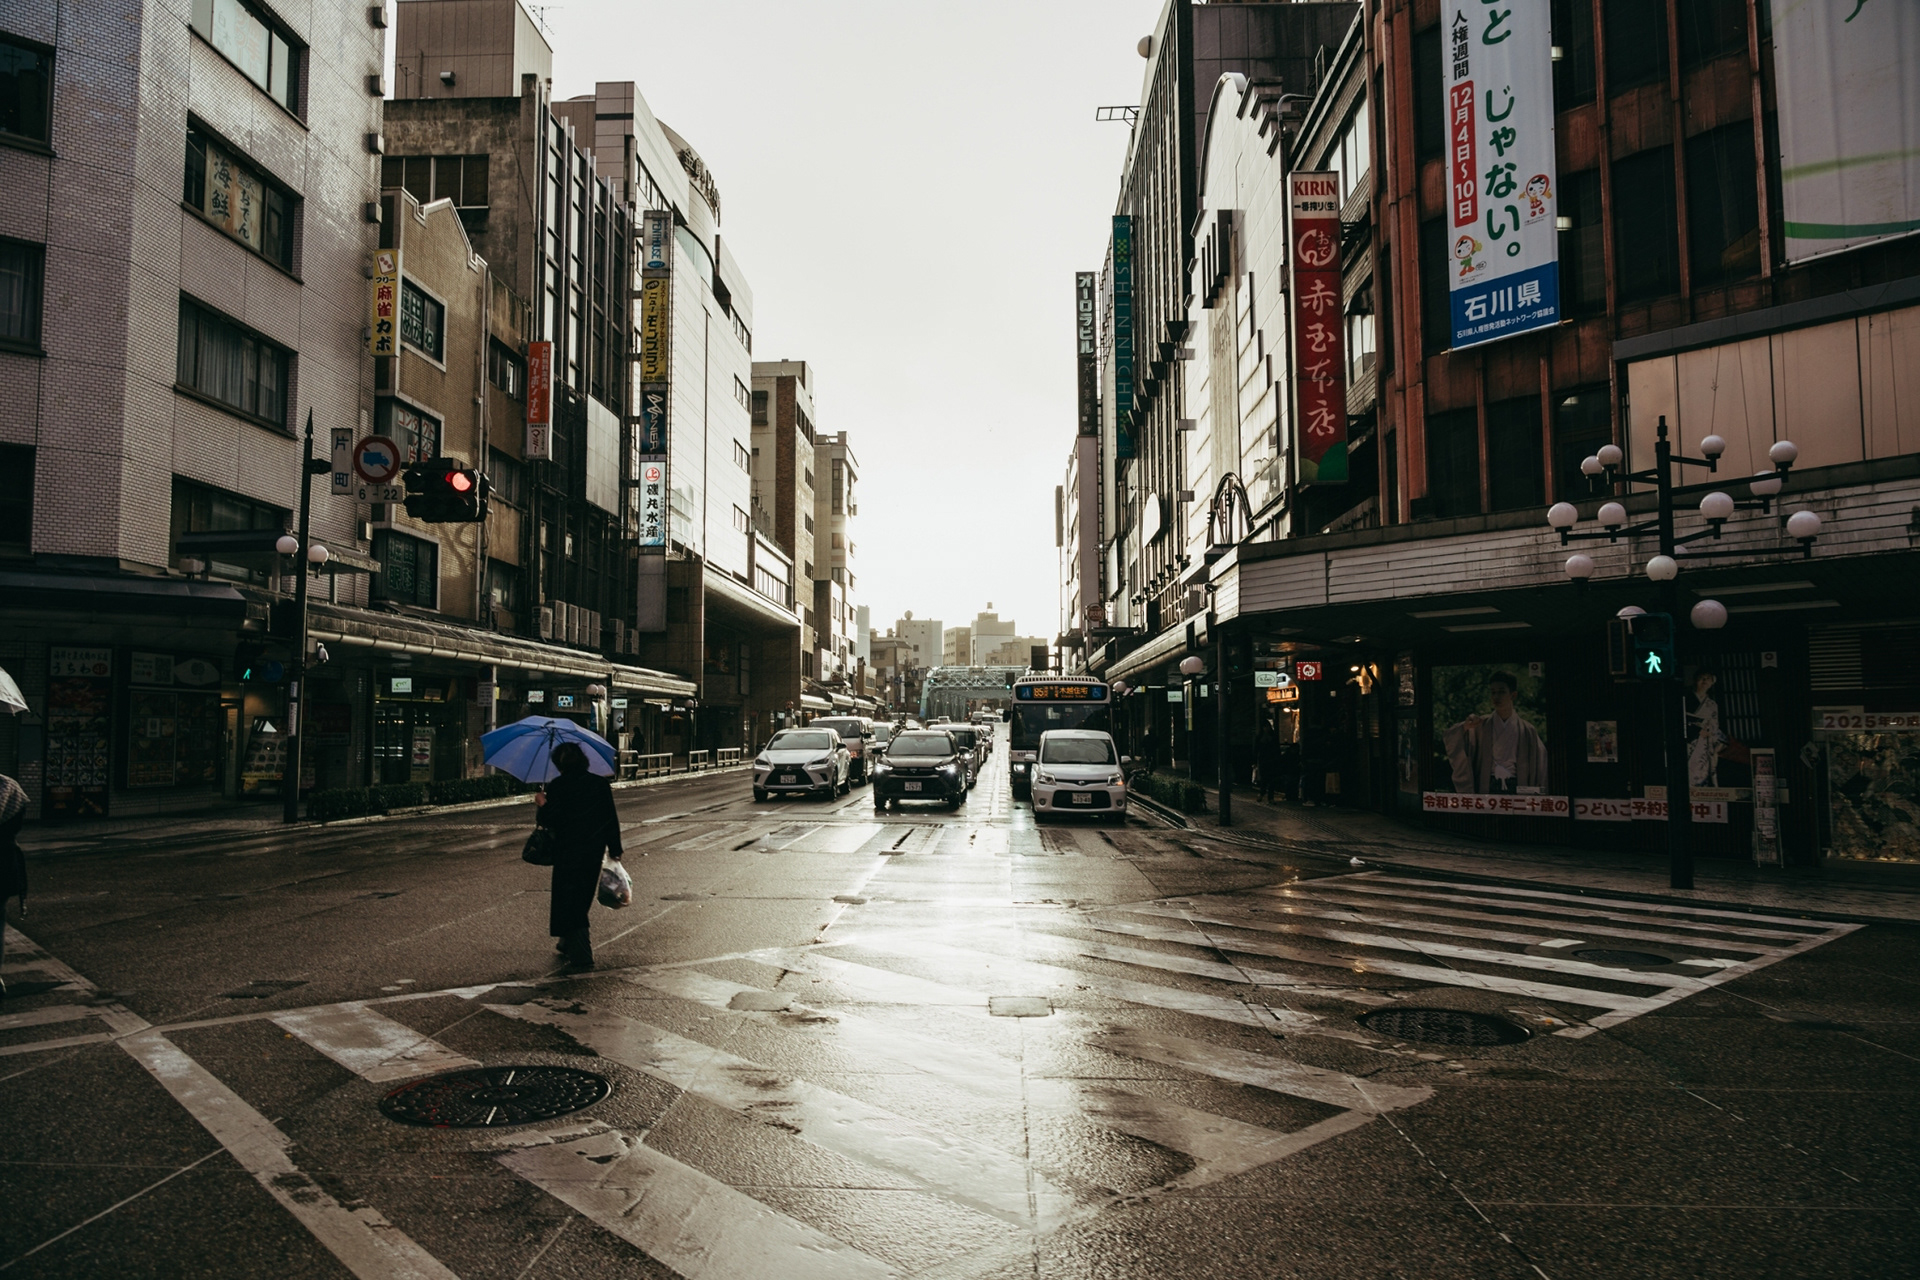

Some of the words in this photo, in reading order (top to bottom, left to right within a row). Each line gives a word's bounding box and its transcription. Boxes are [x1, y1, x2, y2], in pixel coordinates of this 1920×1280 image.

[1452, 9, 1469, 81] 人権週間
[211, 153, 233, 222] 海鮮
[1294, 180, 1337, 196] KIRIN
[651, 219, 662, 259] PENTHOUSE
[376, 285, 393, 352] 麻雀カボ
[1078, 275, 1093, 355] オーロラビル
[1464, 280, 1541, 321] 石川県
[1116, 266, 1131, 405] SHINNICHI
[1300, 278, 1337, 437] 赤玉本店
[398, 409, 435, 441] コンタクト
[335, 436, 349, 488] 片町
[646, 483, 659, 538] 磯丸水産
[52, 661, 91, 674] うちわ
